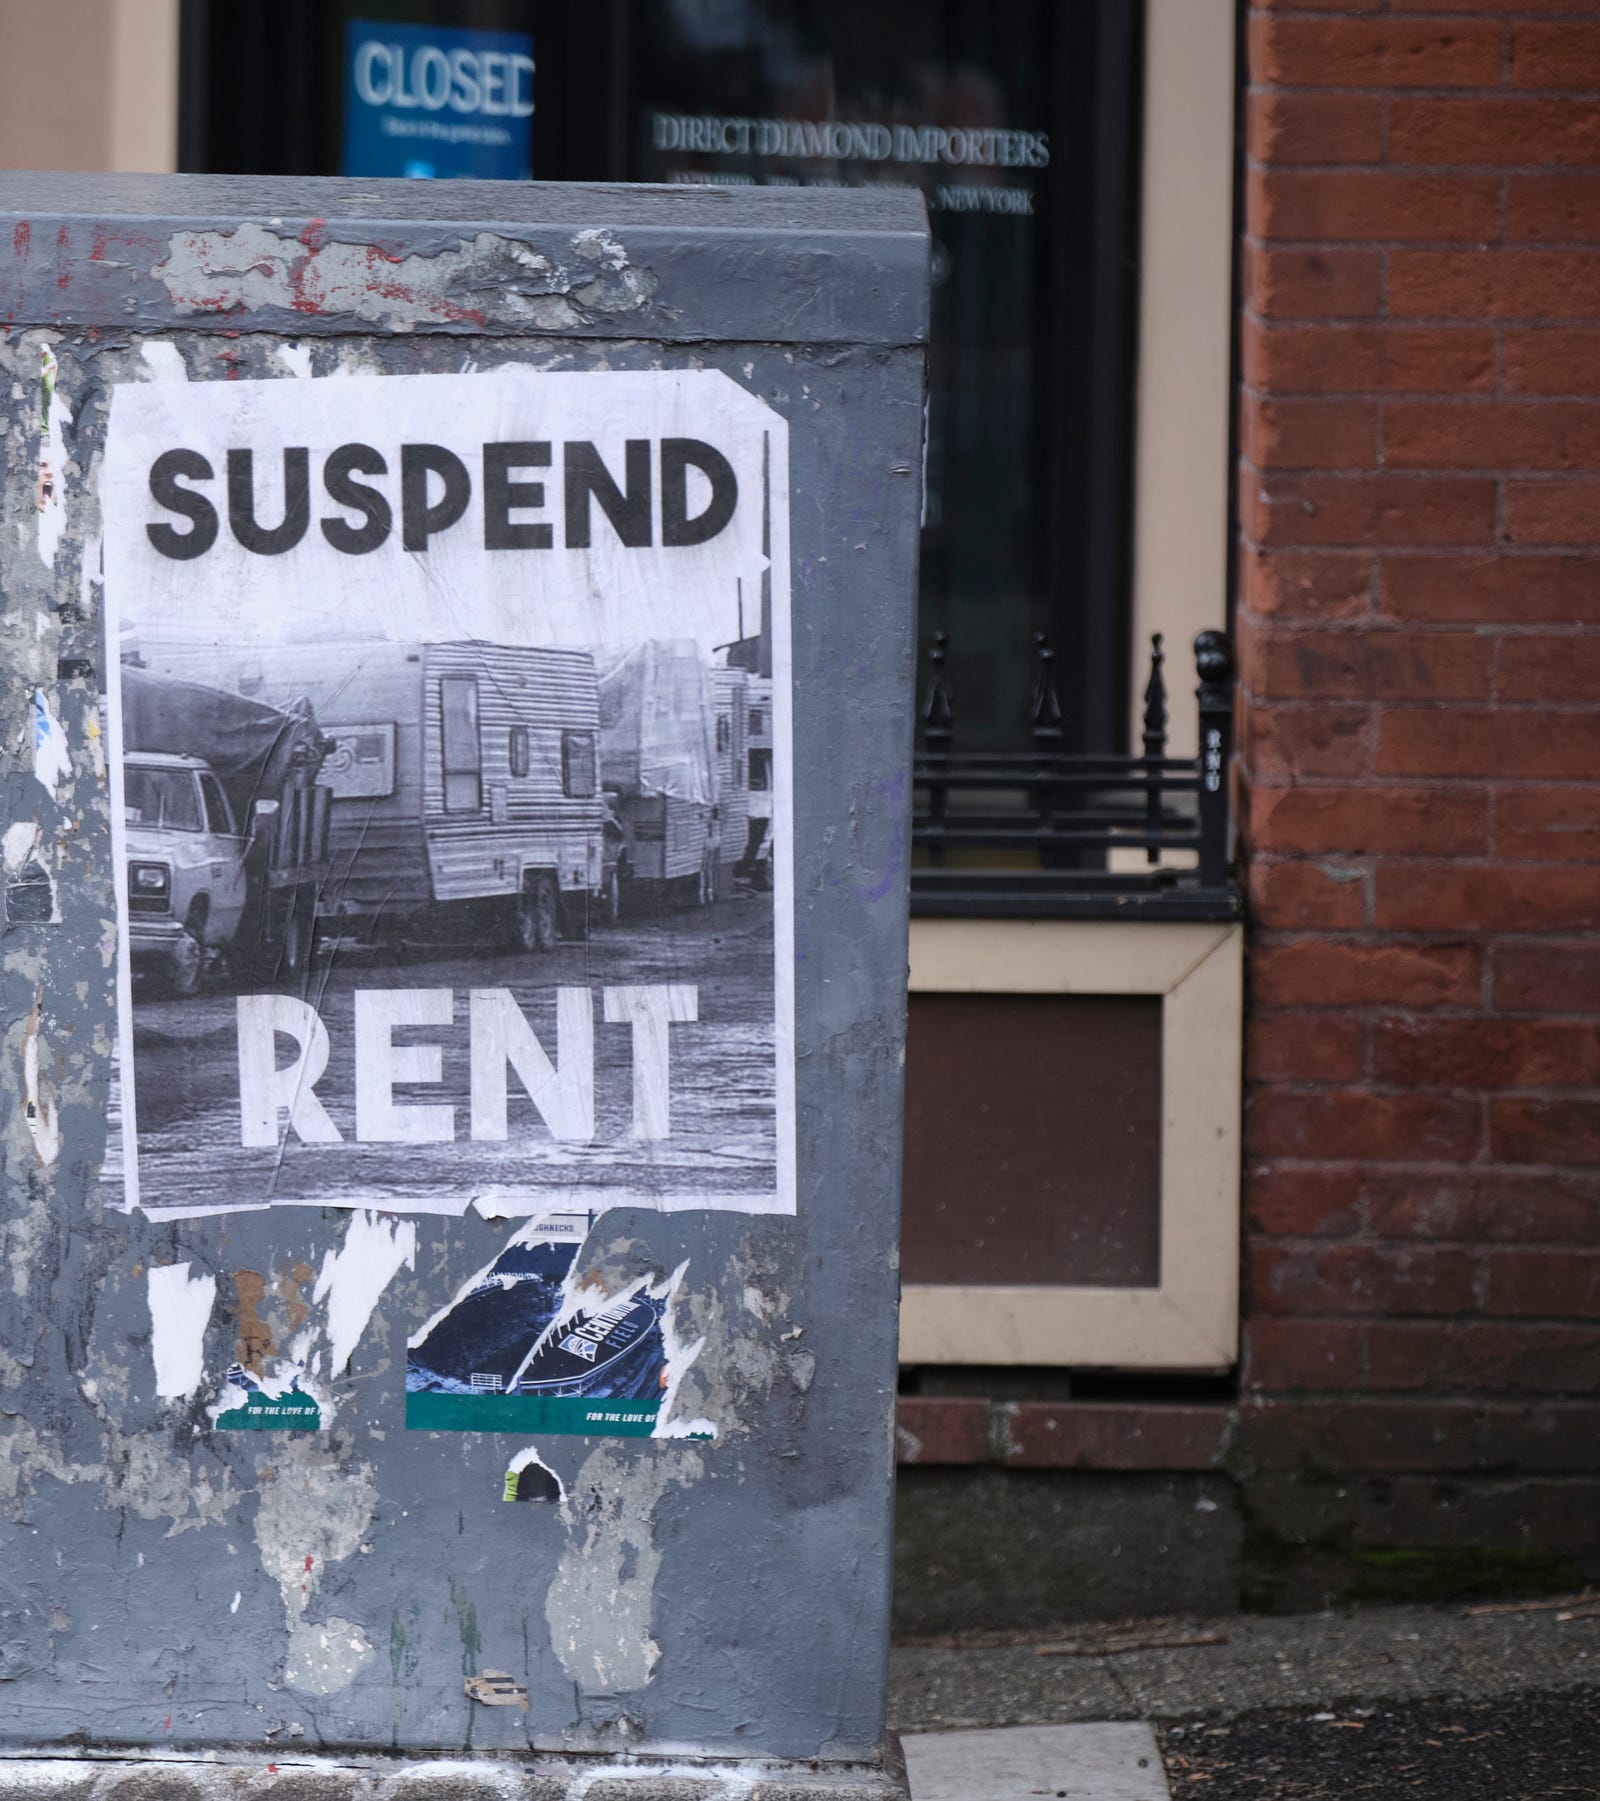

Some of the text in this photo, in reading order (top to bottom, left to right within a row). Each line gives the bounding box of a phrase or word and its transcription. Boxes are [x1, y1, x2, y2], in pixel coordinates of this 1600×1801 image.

[354, 41, 535, 117] CLOSED
[653, 114, 1050, 168] DIRECT DIAMOND IMPORTERS
[937, 183, 1035, 215] NEW YORK
[146, 437, 739, 561] SUSPEND
[237, 985, 699, 1148] RENT
[605, 1321, 640, 1350] FIELD
[248, 1406, 317, 1416] FOR THE LOVE OF
[586, 1412, 657, 1423] FOR THE LOVE OF
